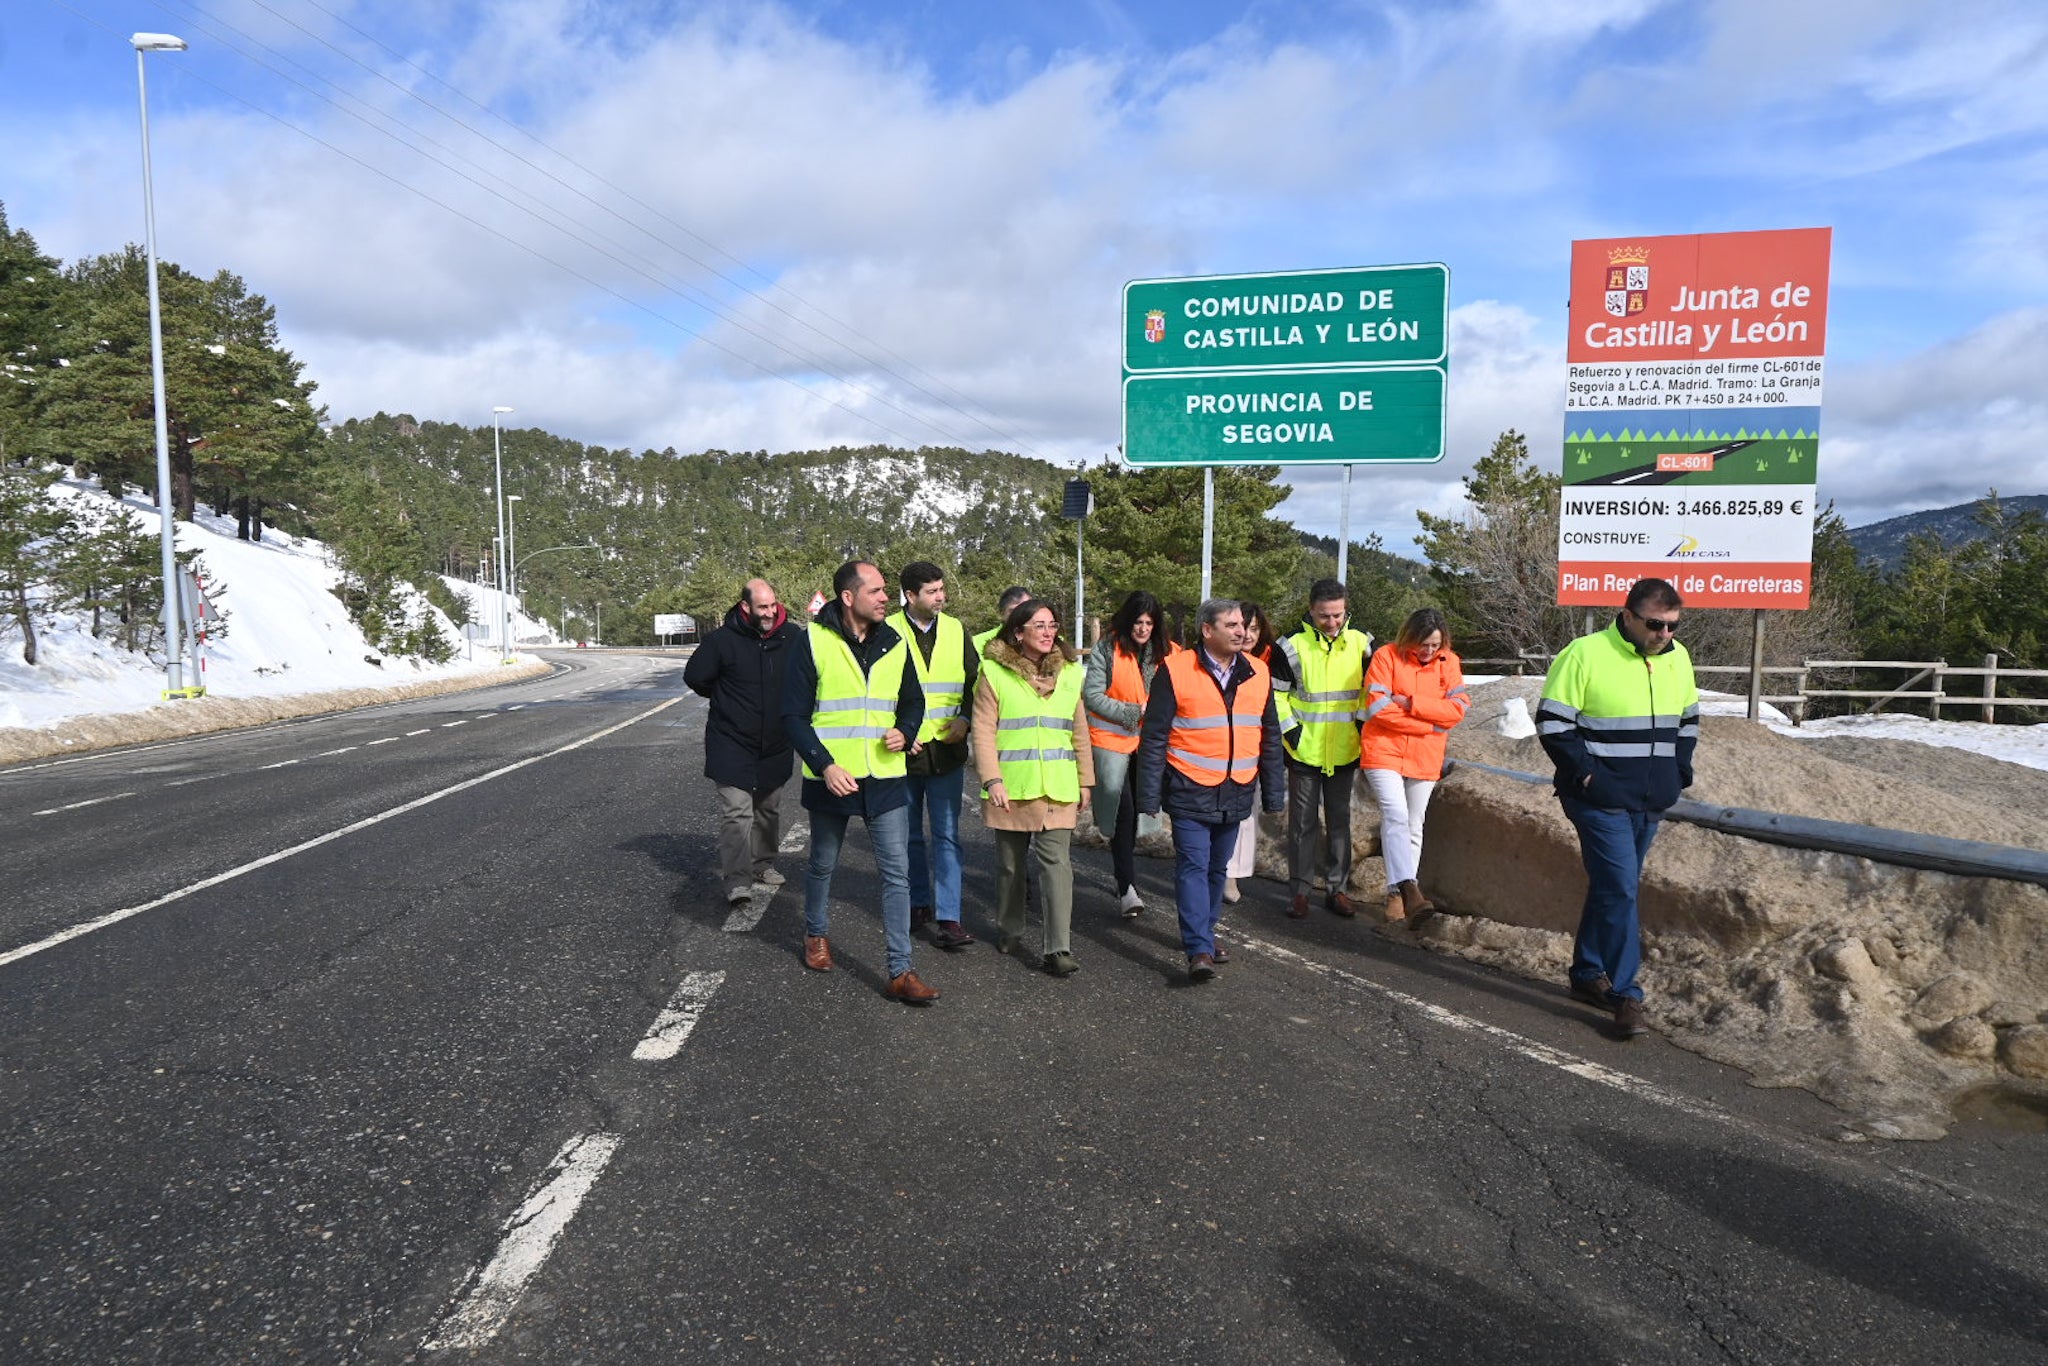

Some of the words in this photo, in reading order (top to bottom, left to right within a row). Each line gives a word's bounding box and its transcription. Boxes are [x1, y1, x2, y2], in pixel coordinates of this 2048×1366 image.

[1184, 291, 1344, 318] COMUNIDAD
[1359, 289, 1393, 310] DE
[1671, 285, 1759, 312] Junta
[1770, 281, 1810, 307] de
[1184, 325, 1304, 349] CASTILLA
[1315, 324, 1331, 344] Y
[1347, 317, 1419, 343] LEÓN
[1585, 320, 1692, 348] Castilla
[1698, 323, 1722, 353] y
[1730, 313, 1808, 344] León
[1569, 366, 1622, 378] Refuerzo
[1625, 367, 1632, 379] y
[1635, 363, 1702, 377] renovación
[1705, 363, 1724, 374] del
[1728, 362, 1759, 374] firme
[1569, 381, 1615, 395] Segovia
[1618, 382, 1625, 391] a
[1629, 380, 1664, 391] L.C.A.
[1668, 379, 1712, 390] Madrid.
[1717, 378, 1757, 389] Tramo:
[1761, 377, 1775, 388] La
[1780, 375, 1820, 389] Granja
[1186, 391, 1323, 414] PROVINCIA
[1339, 391, 1373, 411] DE
[1568, 398, 1575, 407] a
[1579, 395, 1613, 407] L.C.A.
[1617, 395, 1660, 406] Madrid.
[1664, 394, 1681, 405] PK
[1728, 395, 1734, 404] a
[1222, 423, 1334, 444] SEGOVIA
[1661, 455, 1708, 469] CL-601
[1565, 497, 1670, 516] INVERSIÓN:
[1677, 500, 1783, 518] 3.466.825,89
[1790, 500, 1803, 515] €
[1563, 532, 1650, 545] CONSTRUYE:
[1562, 573, 1599, 591] Plan
[1683, 575, 1705, 593] de
[1710, 575, 1803, 594] Carreteras
